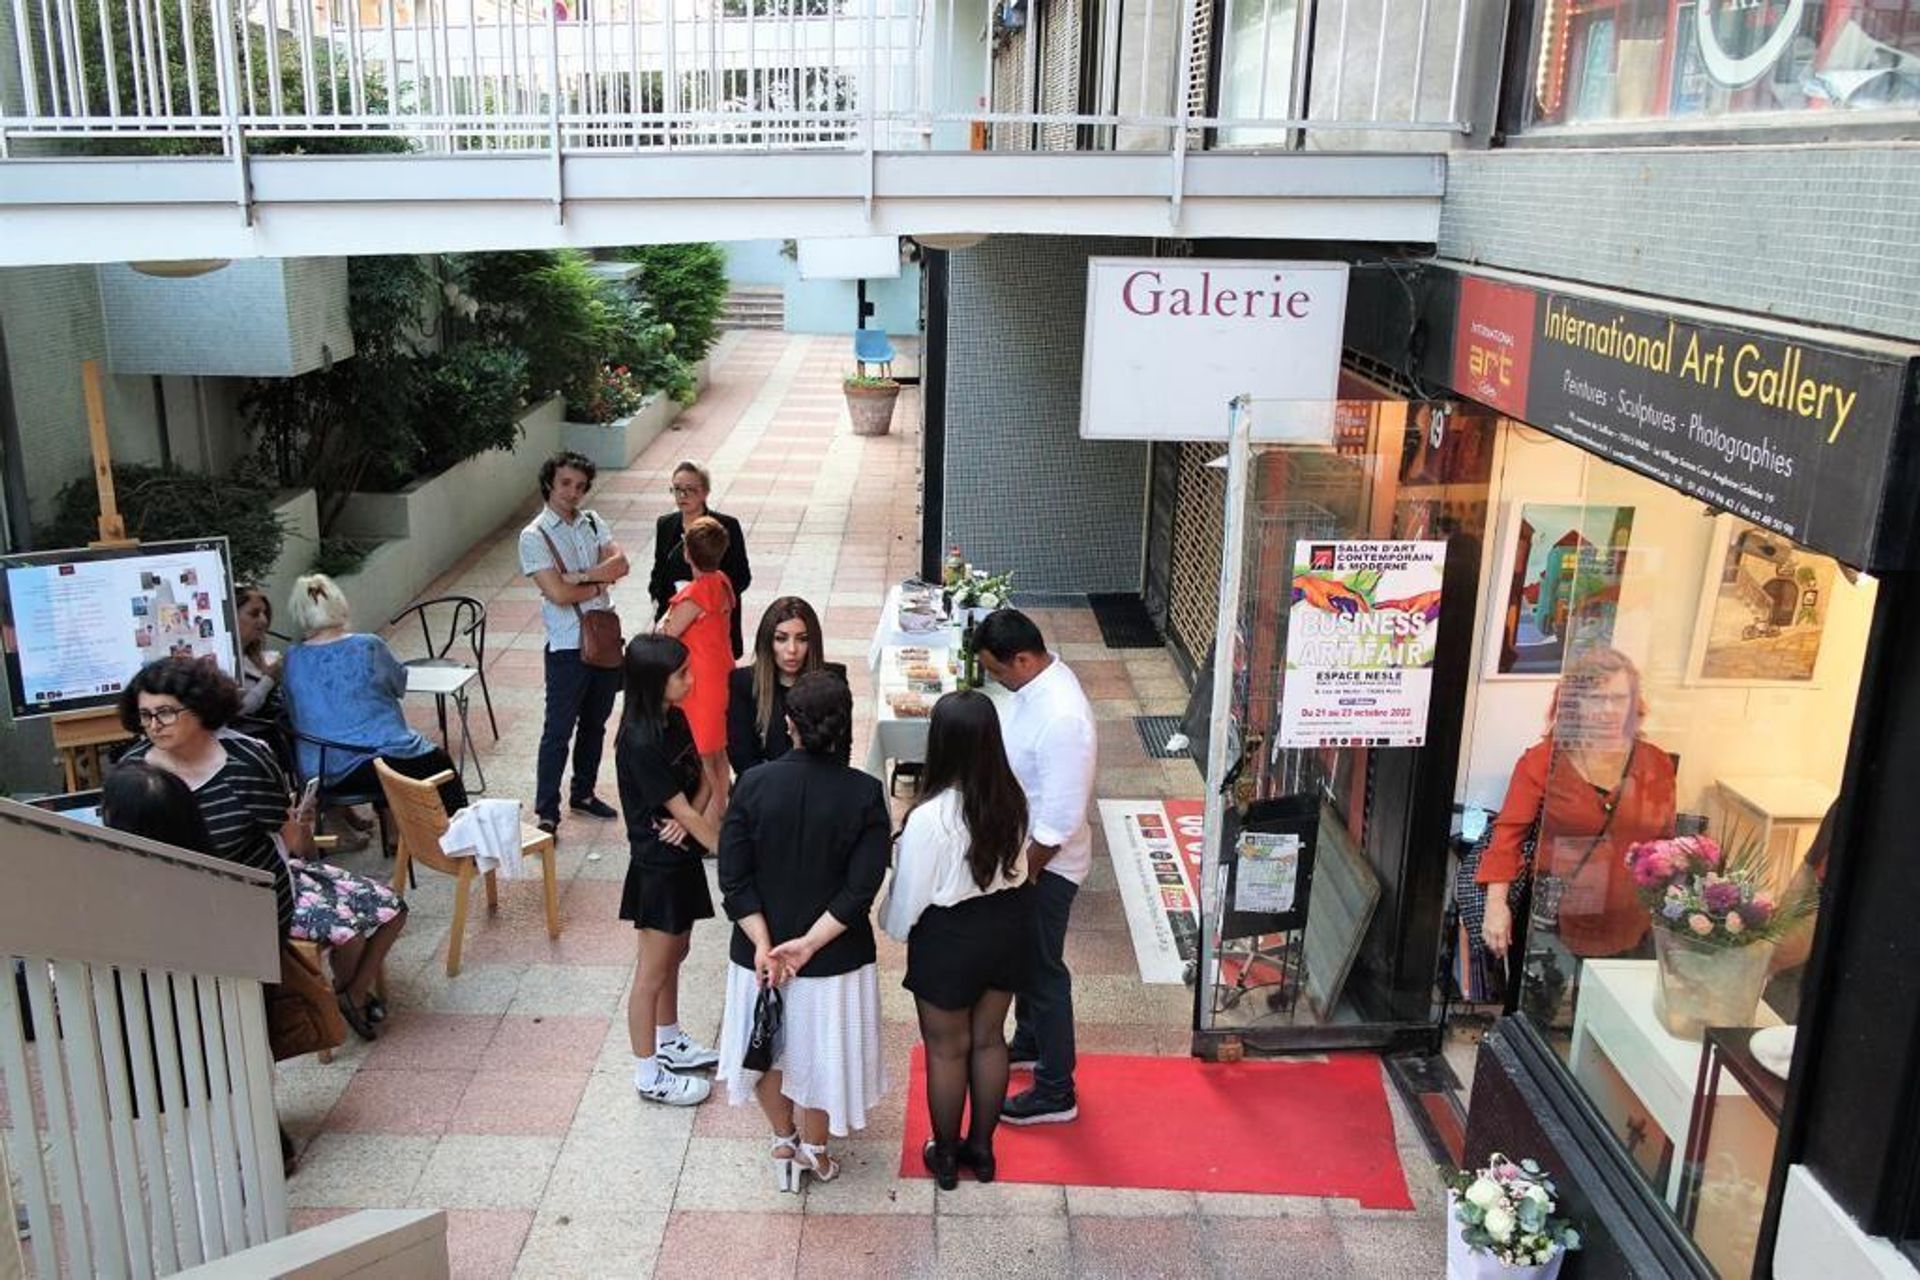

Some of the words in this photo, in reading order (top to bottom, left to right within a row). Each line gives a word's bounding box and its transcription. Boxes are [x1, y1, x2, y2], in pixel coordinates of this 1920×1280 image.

[1122, 270, 1310, 318] Galerie
[1470, 344, 1513, 386] art
[1544, 297, 1675, 373] International
[1680, 331, 1724, 389] Art
[1732, 344, 1857, 443] Gallery
[1563, 368, 1607, 407] Peintures
[1617, 388, 1676, 433] Sculptures
[1688, 412, 1793, 477] Photographies
[1337, 552, 1433, 562] CONTEMPORAIN
[1338, 544, 1378, 552] SALON
[1382, 544, 1416, 552] D'ART
[1350, 562, 1408, 571] MODERNE
[1302, 612, 1427, 636] BUSINESS
[1302, 641, 1356, 666] ART
[1363, 641, 1425, 666] FAIR
[1316, 672, 1360, 680] ESPACE
[1365, 672, 1402, 680] NESLE
[1302, 708, 1313, 717] Du
[1328, 709, 1339, 717] au
[1354, 708, 1388, 717] octobre
[1390, 708, 1411, 717] 2022
